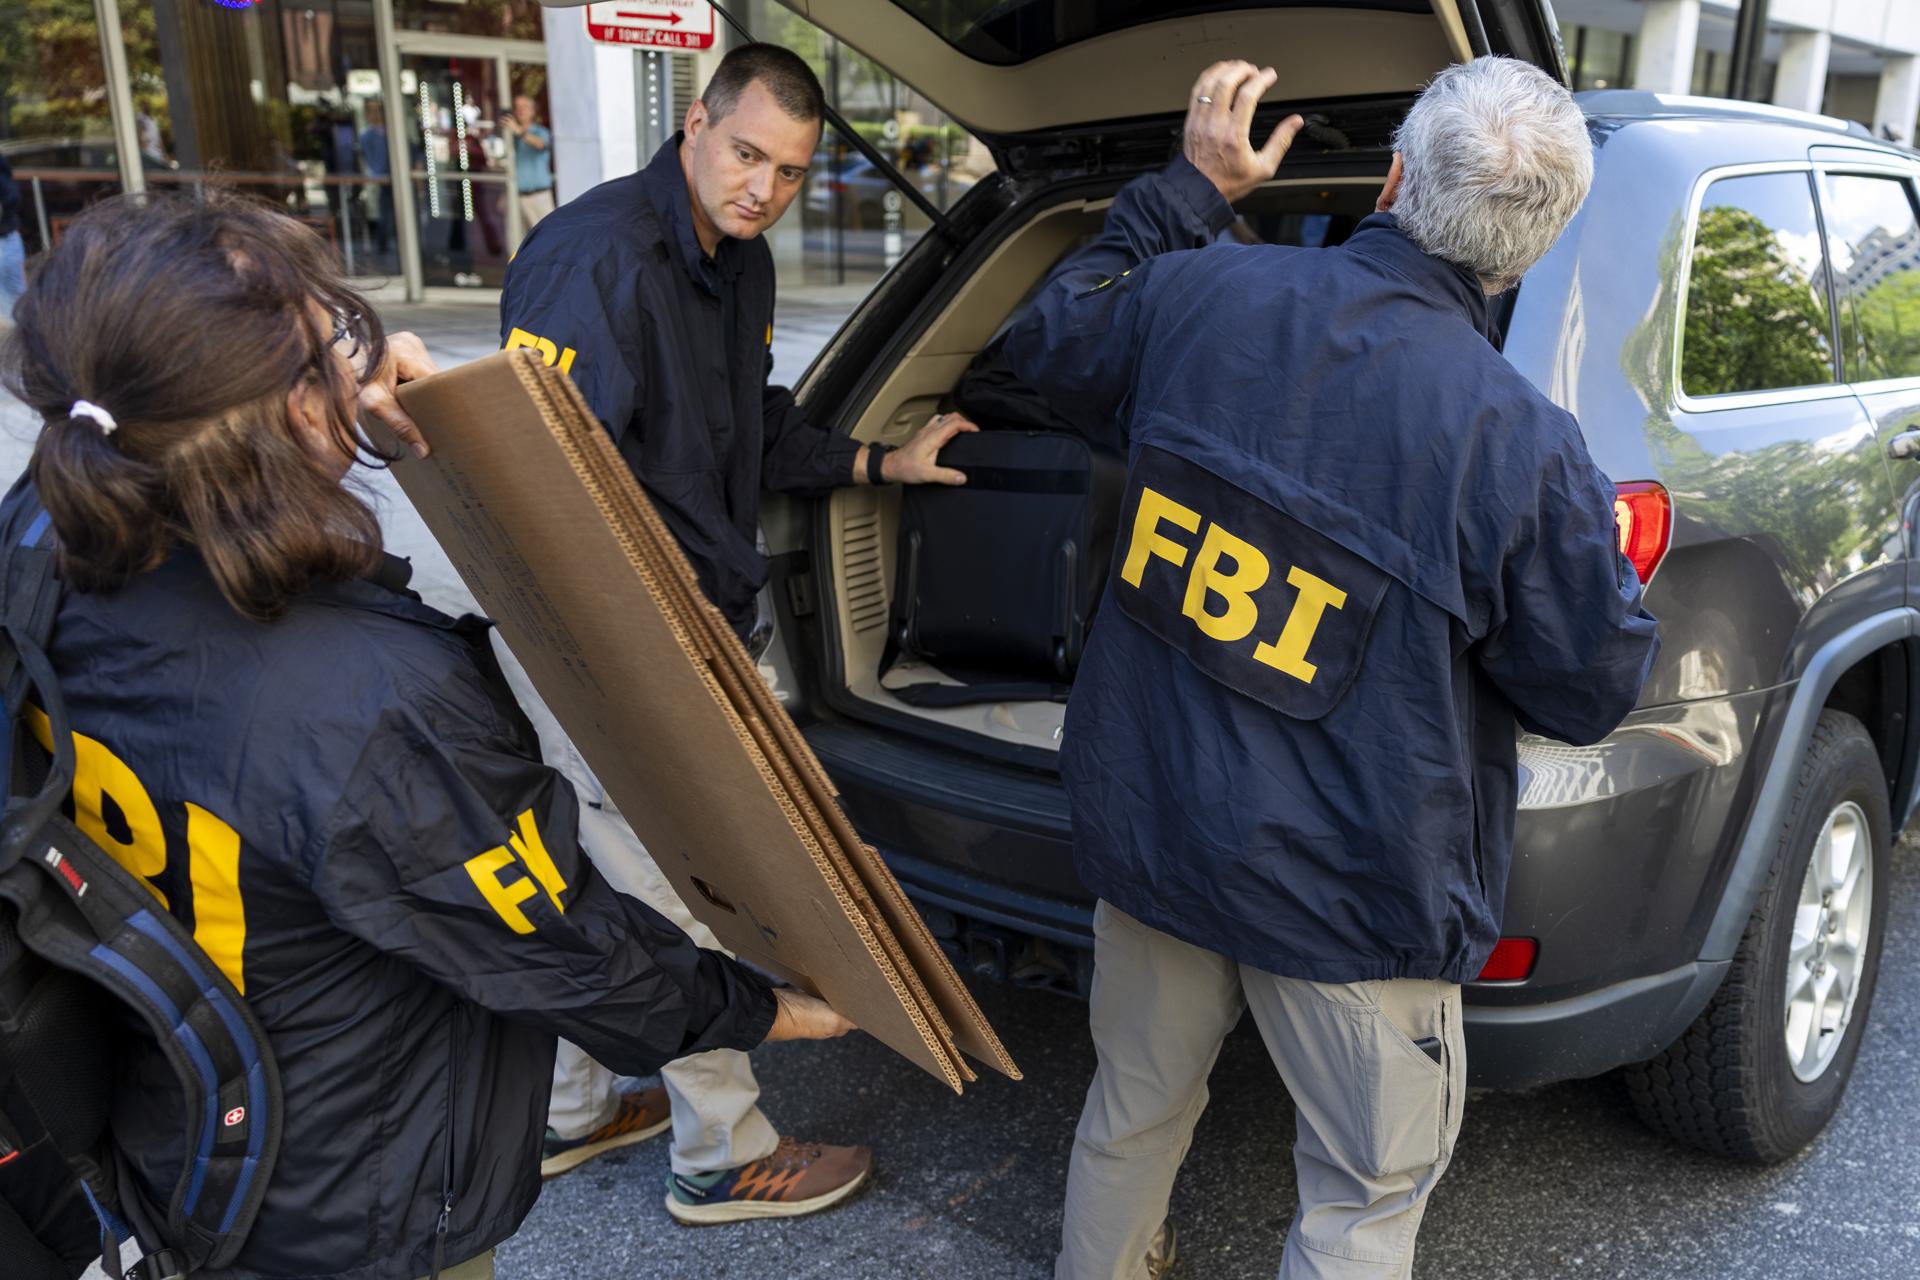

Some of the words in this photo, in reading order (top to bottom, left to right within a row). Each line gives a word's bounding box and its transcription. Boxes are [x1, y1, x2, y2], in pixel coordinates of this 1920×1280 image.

[604, 27, 615, 40] IF
[618, 28, 654, 43] TOWED
[655, 30, 682, 46] CALL
[1121, 486, 1348, 685] FBI
[22, 700, 247, 998] BI
